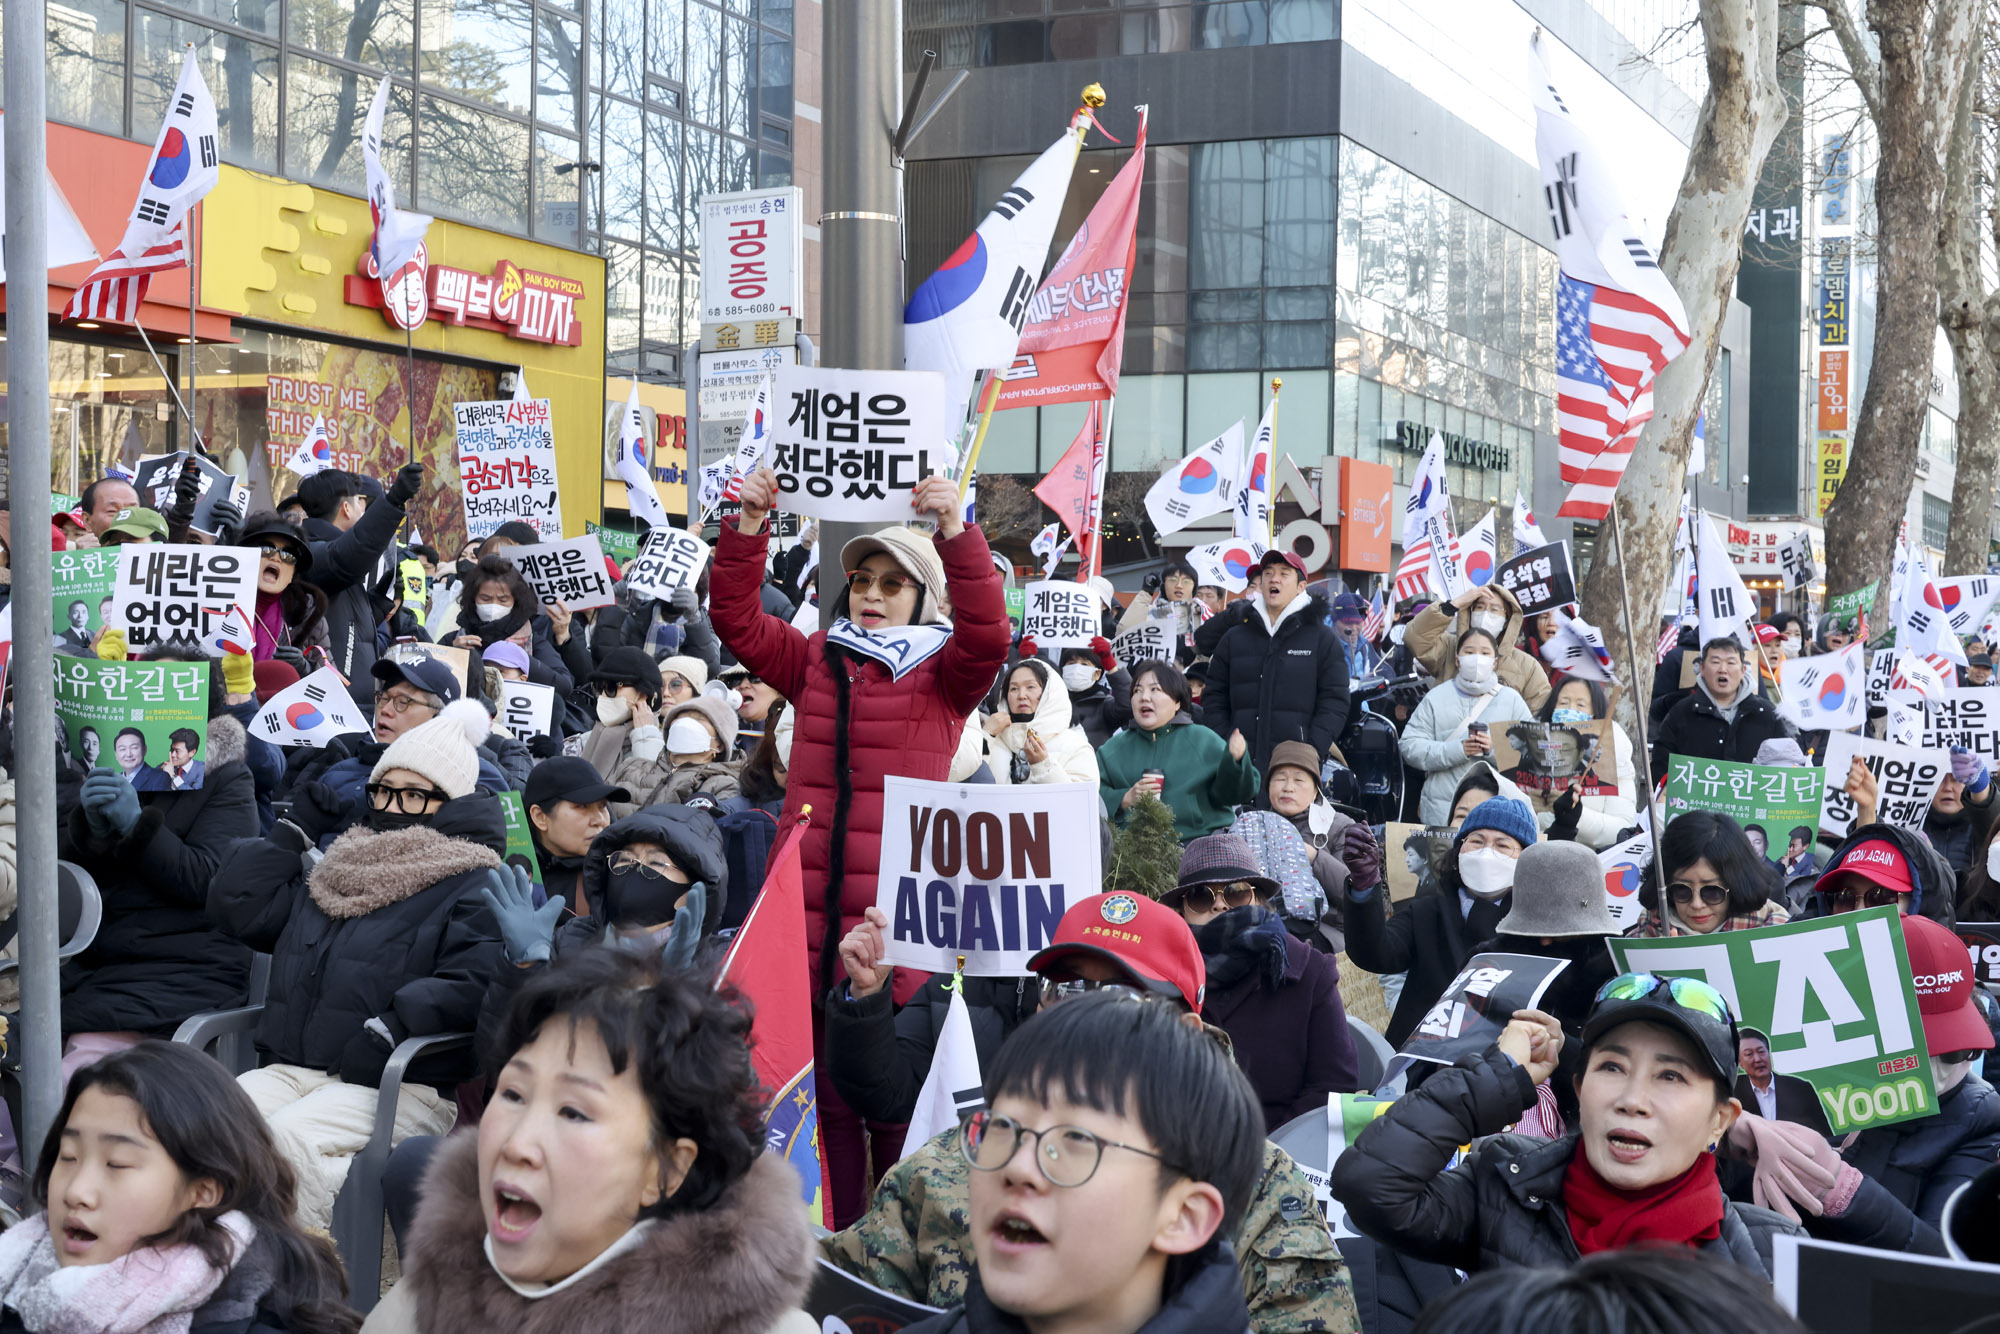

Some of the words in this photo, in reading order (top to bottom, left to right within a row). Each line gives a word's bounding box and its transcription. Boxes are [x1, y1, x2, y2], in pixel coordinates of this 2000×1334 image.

[760, 198, 786, 215] 송현
[727, 219, 768, 300] 공증
[525, 273, 543, 286] PAIK
[544, 276, 560, 289] BOY
[561, 280, 583, 296] PIZZA
[725, 303, 775, 316] 585-6080
[268, 377, 334, 406] TRUST
[340, 387, 372, 413] ME,
[268, 410, 314, 437] THIS
[457, 405, 506, 427] 대한민국
[506, 400, 550, 426] 사법부
[788, 388, 911, 444] 계엄은
[331, 450, 362, 473] EST
[772, 443, 935, 501] 정당했다
[517, 549, 586, 581] 계엄은
[641, 530, 699, 570] 란은
[129, 551, 242, 599] 내란은
[1502, 556, 1552, 590] 윤석열
[1033, 590, 1091, 616] 계엄은
[1515, 582, 1551, 608] 무죄
[1026, 615, 1099, 638] 정당했다
[54, 657, 206, 702] 자유한길단
[1672, 760, 1822, 803] 자유한길단
[909, 804, 1052, 881] YOON
[1865, 849, 1895, 867] AGAIN
[893, 876, 1066, 952] AGAIN
[1937, 969, 1965, 986] PARK
[1878, 1054, 1919, 1077] 대윤회
[1822, 1079, 1926, 1128] Yoon
